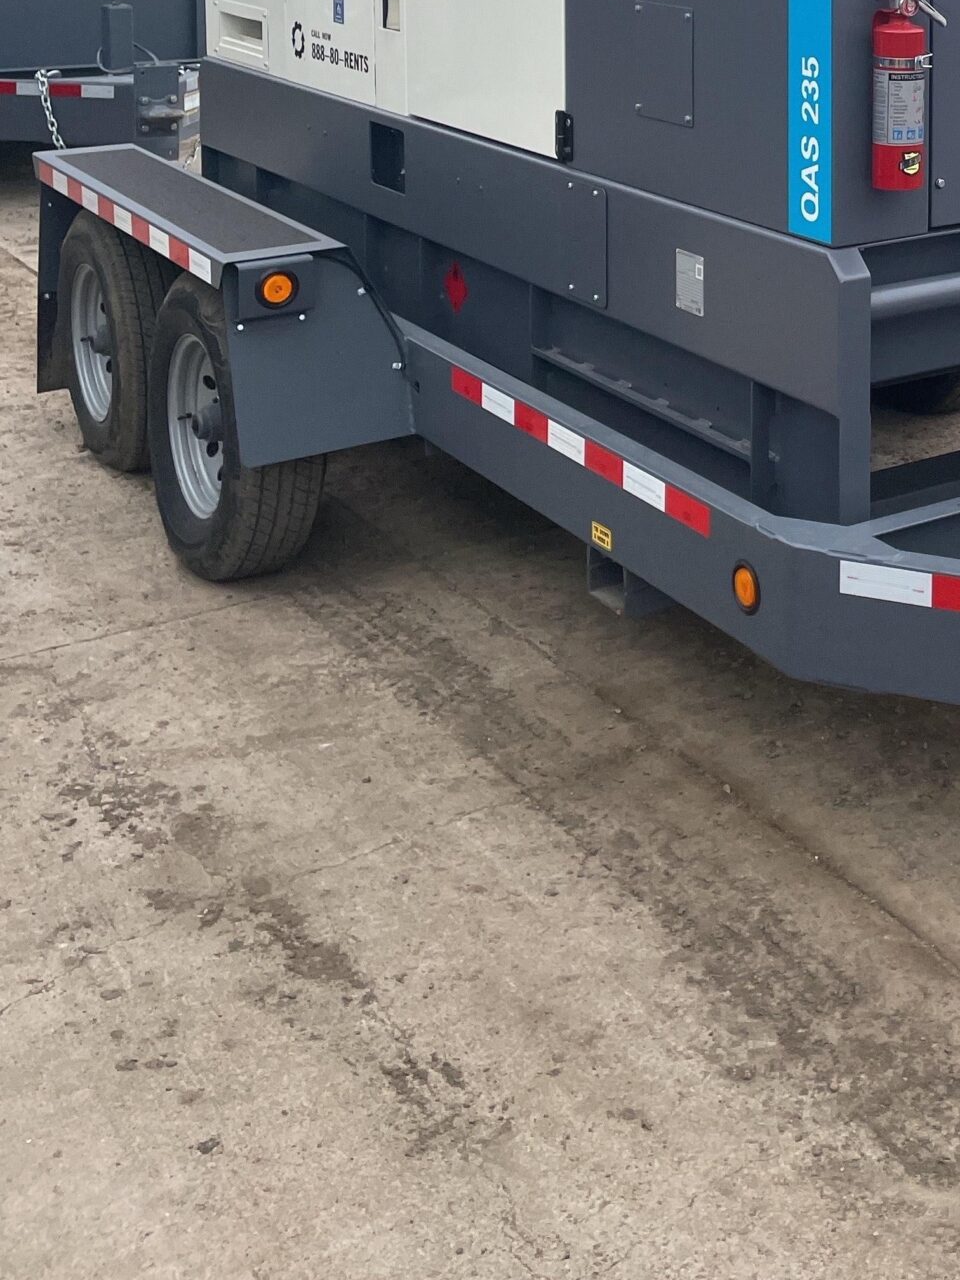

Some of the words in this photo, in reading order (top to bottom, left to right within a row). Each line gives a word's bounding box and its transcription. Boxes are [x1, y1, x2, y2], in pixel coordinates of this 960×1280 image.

[311, 41, 370, 74] 888-80-RENTS
[801, 55, 820, 126] 235
[800, 135, 820, 222] QAS
